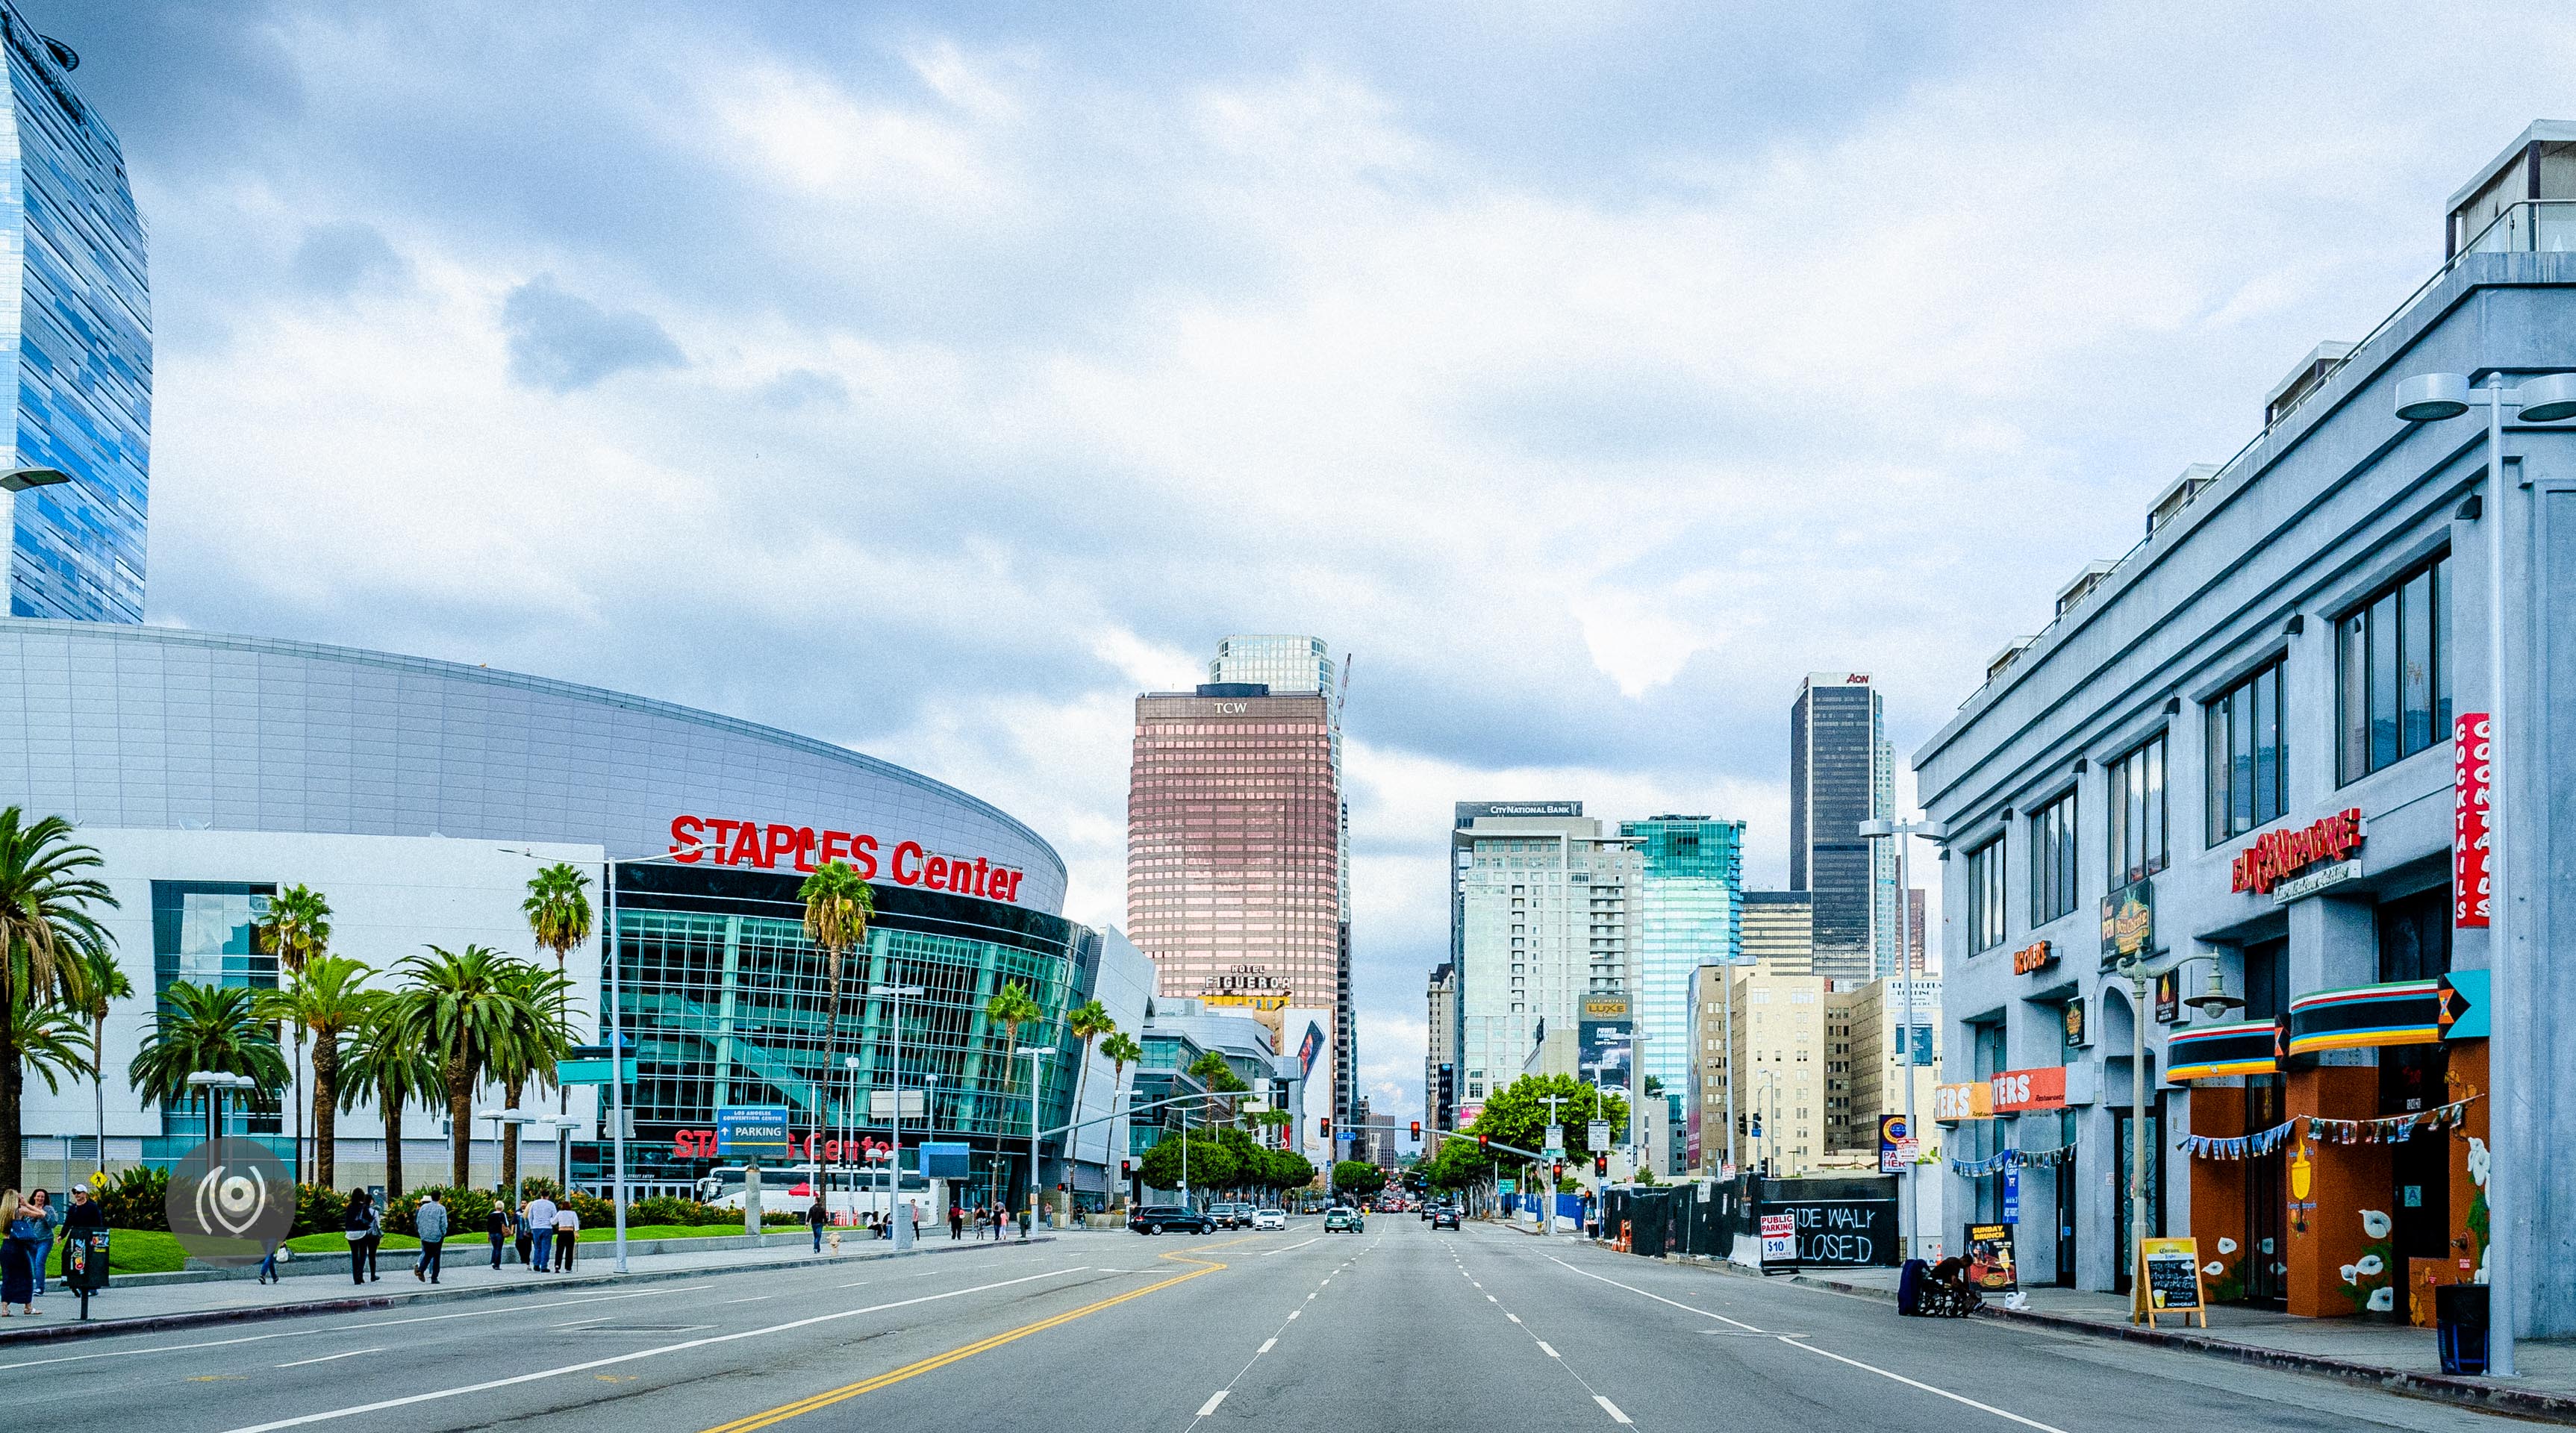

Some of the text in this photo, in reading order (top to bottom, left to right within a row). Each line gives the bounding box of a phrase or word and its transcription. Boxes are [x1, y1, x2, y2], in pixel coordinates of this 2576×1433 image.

[1214, 702, 1247, 714] TCW
[1547, 805, 1570, 814] BANK
[2456, 722, 2466, 920] COCKTAILS
[669, 814, 1023, 903] STAPLES Center
[2232, 848, 2255, 893] EL
[2014, 940, 2050, 975] HOOTERS
[1231, 965, 1265, 973] HOTEL
[1205, 976, 1291, 988] FIGUEROA
[1585, 1004, 1625, 1013] LUXE
[1992, 1074, 2030, 1106] TERS
[735, 1127, 782, 1137] PARKING
[2409, 1189, 2417, 1200] A
[1762, 1215, 1792, 1225] PUBLIC
[1828, 1208, 1876, 1229] WALK
[1762, 1223, 1793, 1232] PARKING
[1972, 1225, 2003, 1234] SUNDAY
[1974, 1231, 2005, 1240] BRUNCH
[1768, 1240, 1784, 1252] $10
